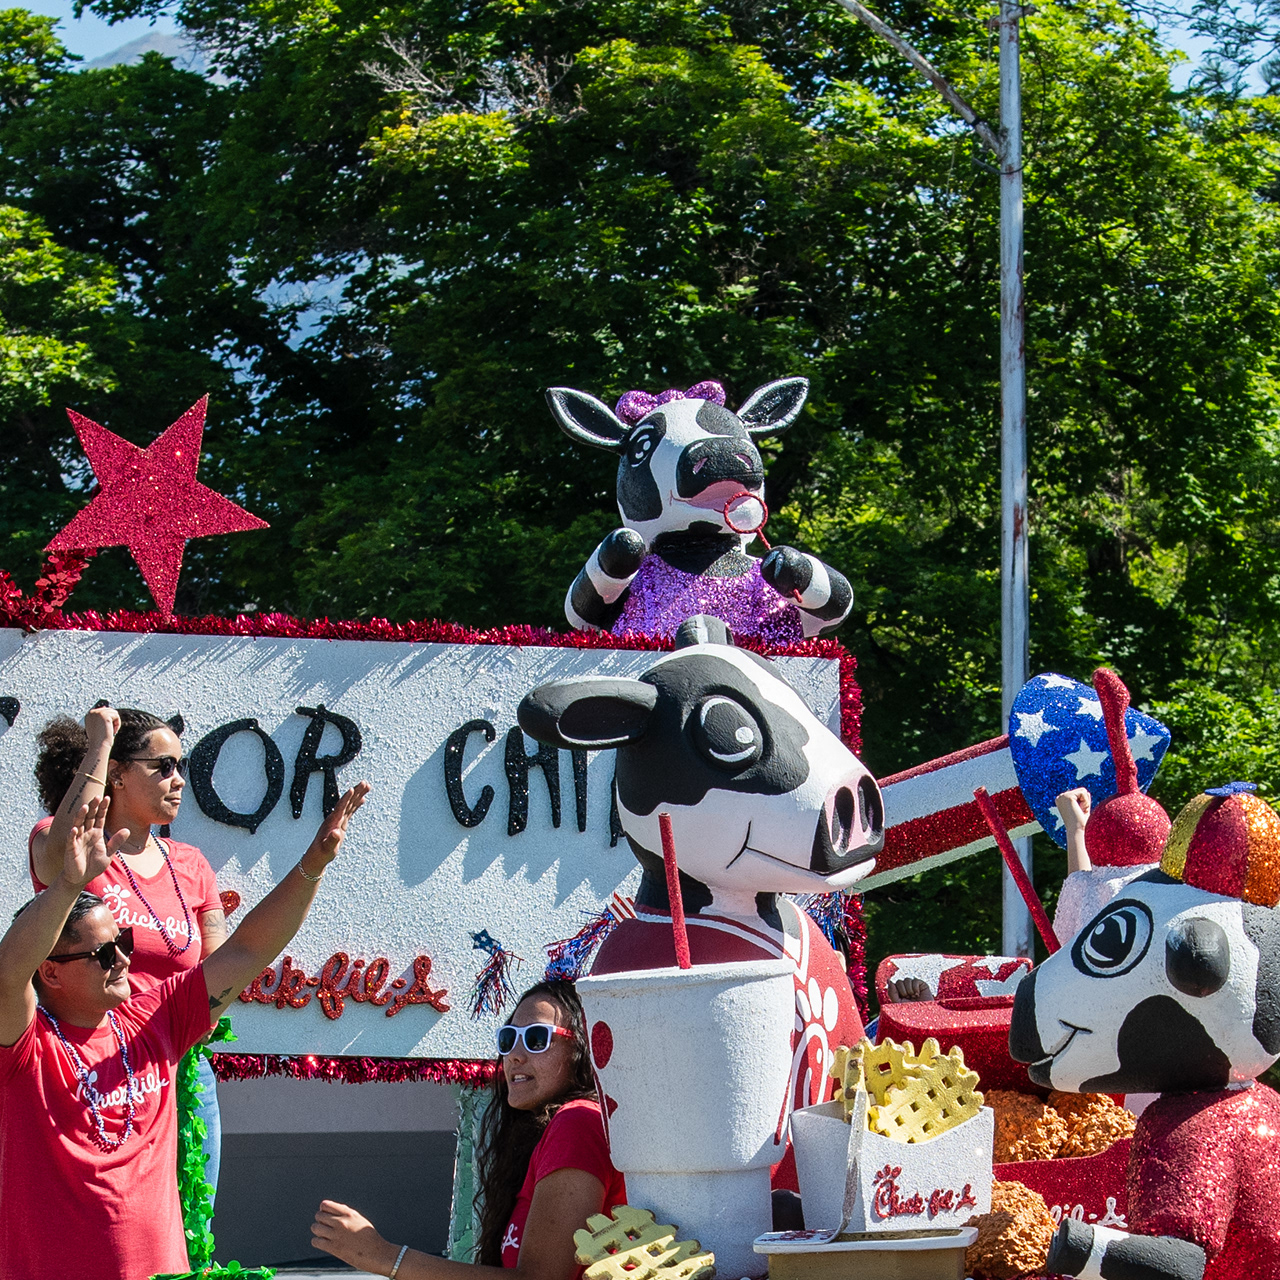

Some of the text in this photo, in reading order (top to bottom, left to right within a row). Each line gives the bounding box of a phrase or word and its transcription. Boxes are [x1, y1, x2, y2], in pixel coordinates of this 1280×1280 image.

[444, 718, 625, 847] CHI
[239, 951, 451, 1021] ck-fil-A
[874, 1177, 977, 1219] Chick-fil-A
